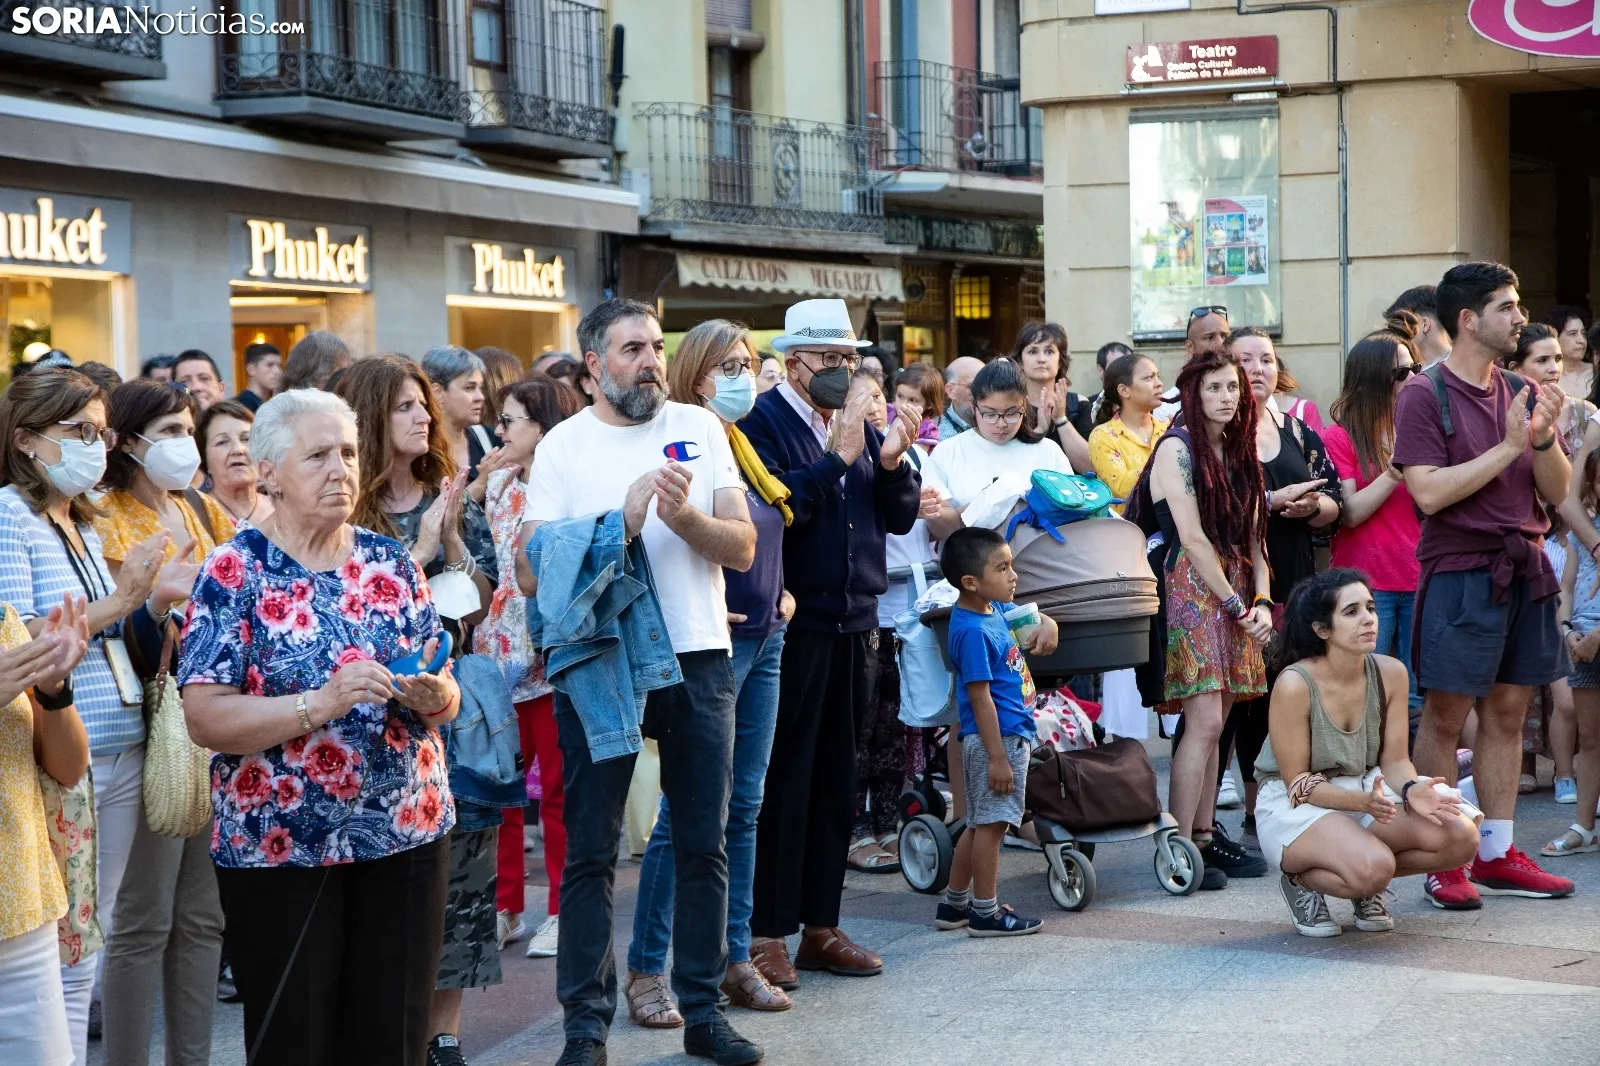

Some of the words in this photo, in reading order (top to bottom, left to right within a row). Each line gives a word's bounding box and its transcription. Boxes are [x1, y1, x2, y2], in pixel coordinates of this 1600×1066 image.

[1189, 45, 1237, 58] Teatro
[1167, 61, 1197, 70] Centro
[1198, 59, 1232, 69] Cultural
[1200, 69, 1211, 78] de
[1213, 68, 1221, 77] la
[1223, 66, 1267, 76] Audiencia
[246, 219, 369, 283] Phuket
[472, 242, 566, 298] Phuket
[701, 257, 787, 283] CALZADOS
[811, 267, 882, 292] MUGARZA
